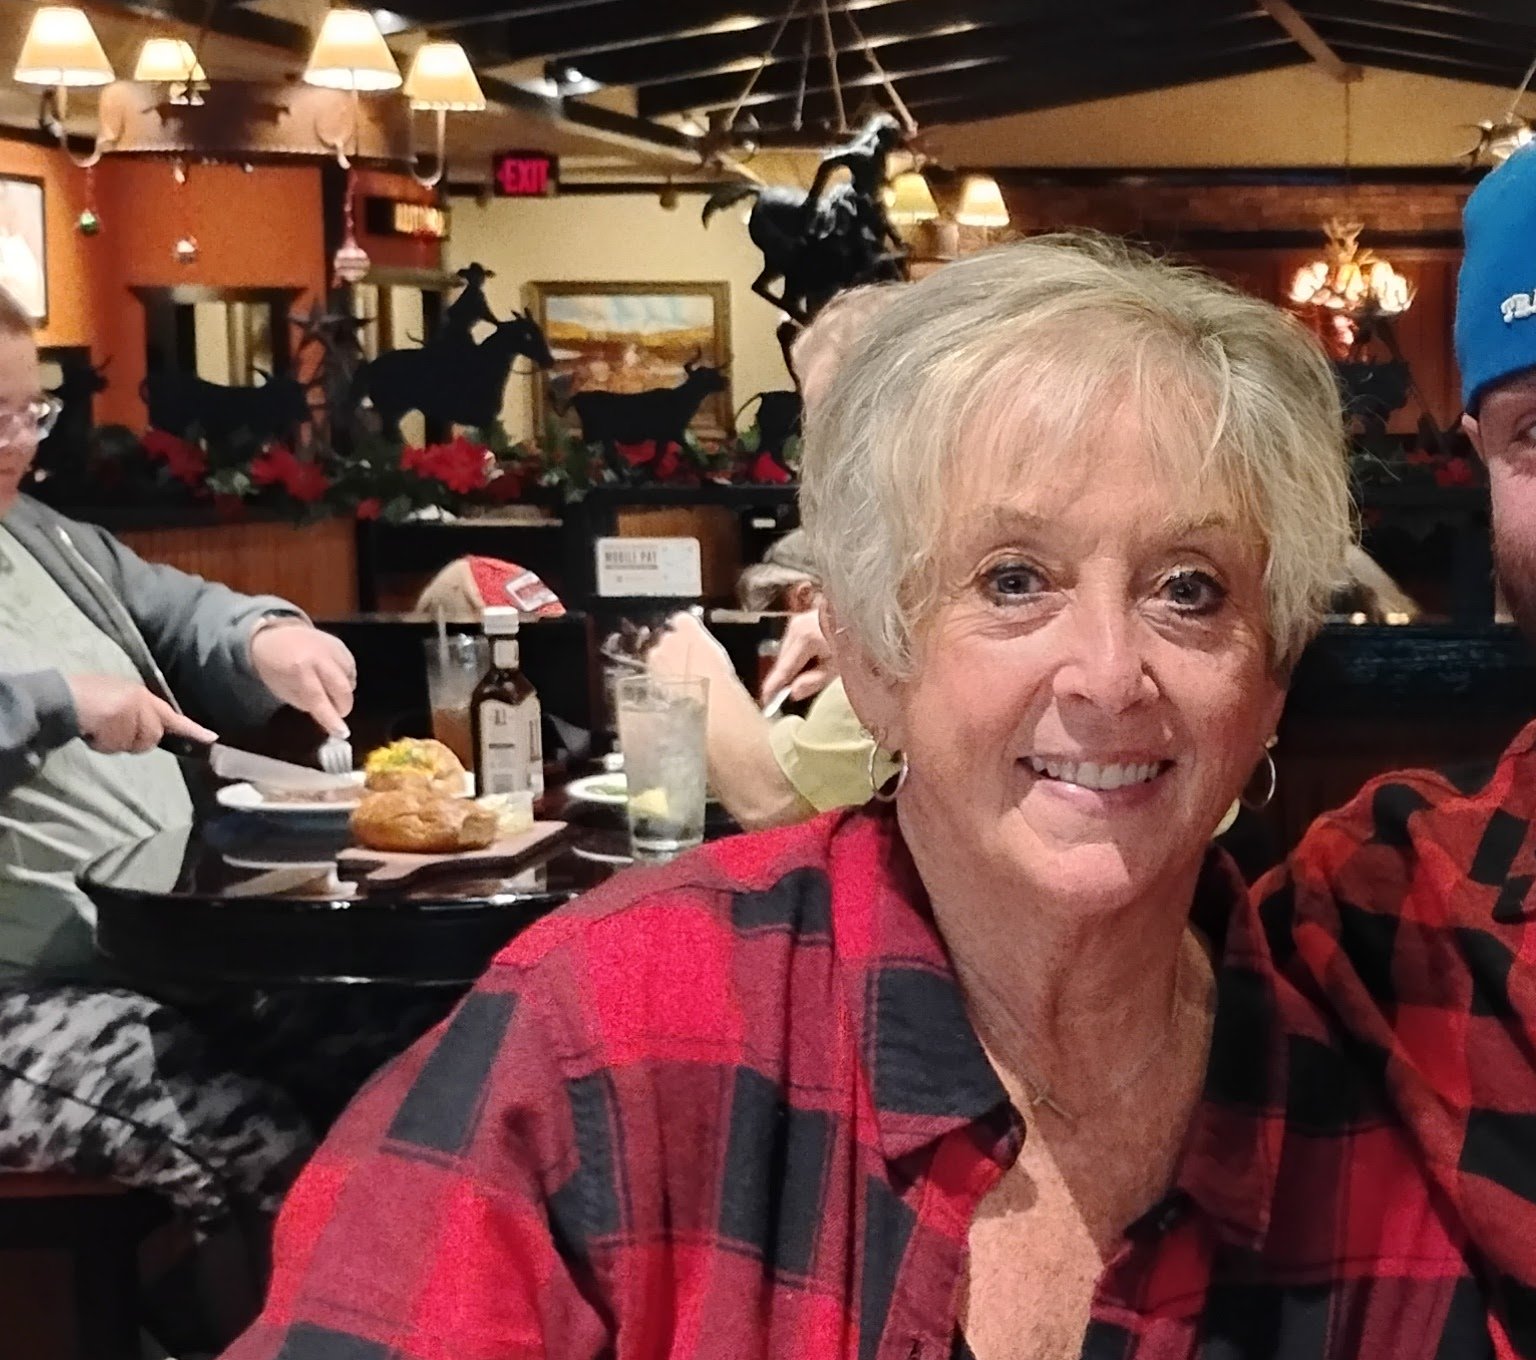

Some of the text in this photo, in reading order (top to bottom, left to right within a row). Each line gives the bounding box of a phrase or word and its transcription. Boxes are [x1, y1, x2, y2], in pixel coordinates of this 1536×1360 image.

[503, 158, 549, 193] EXIT
[604, 551, 657, 563] MOBILE PAY
